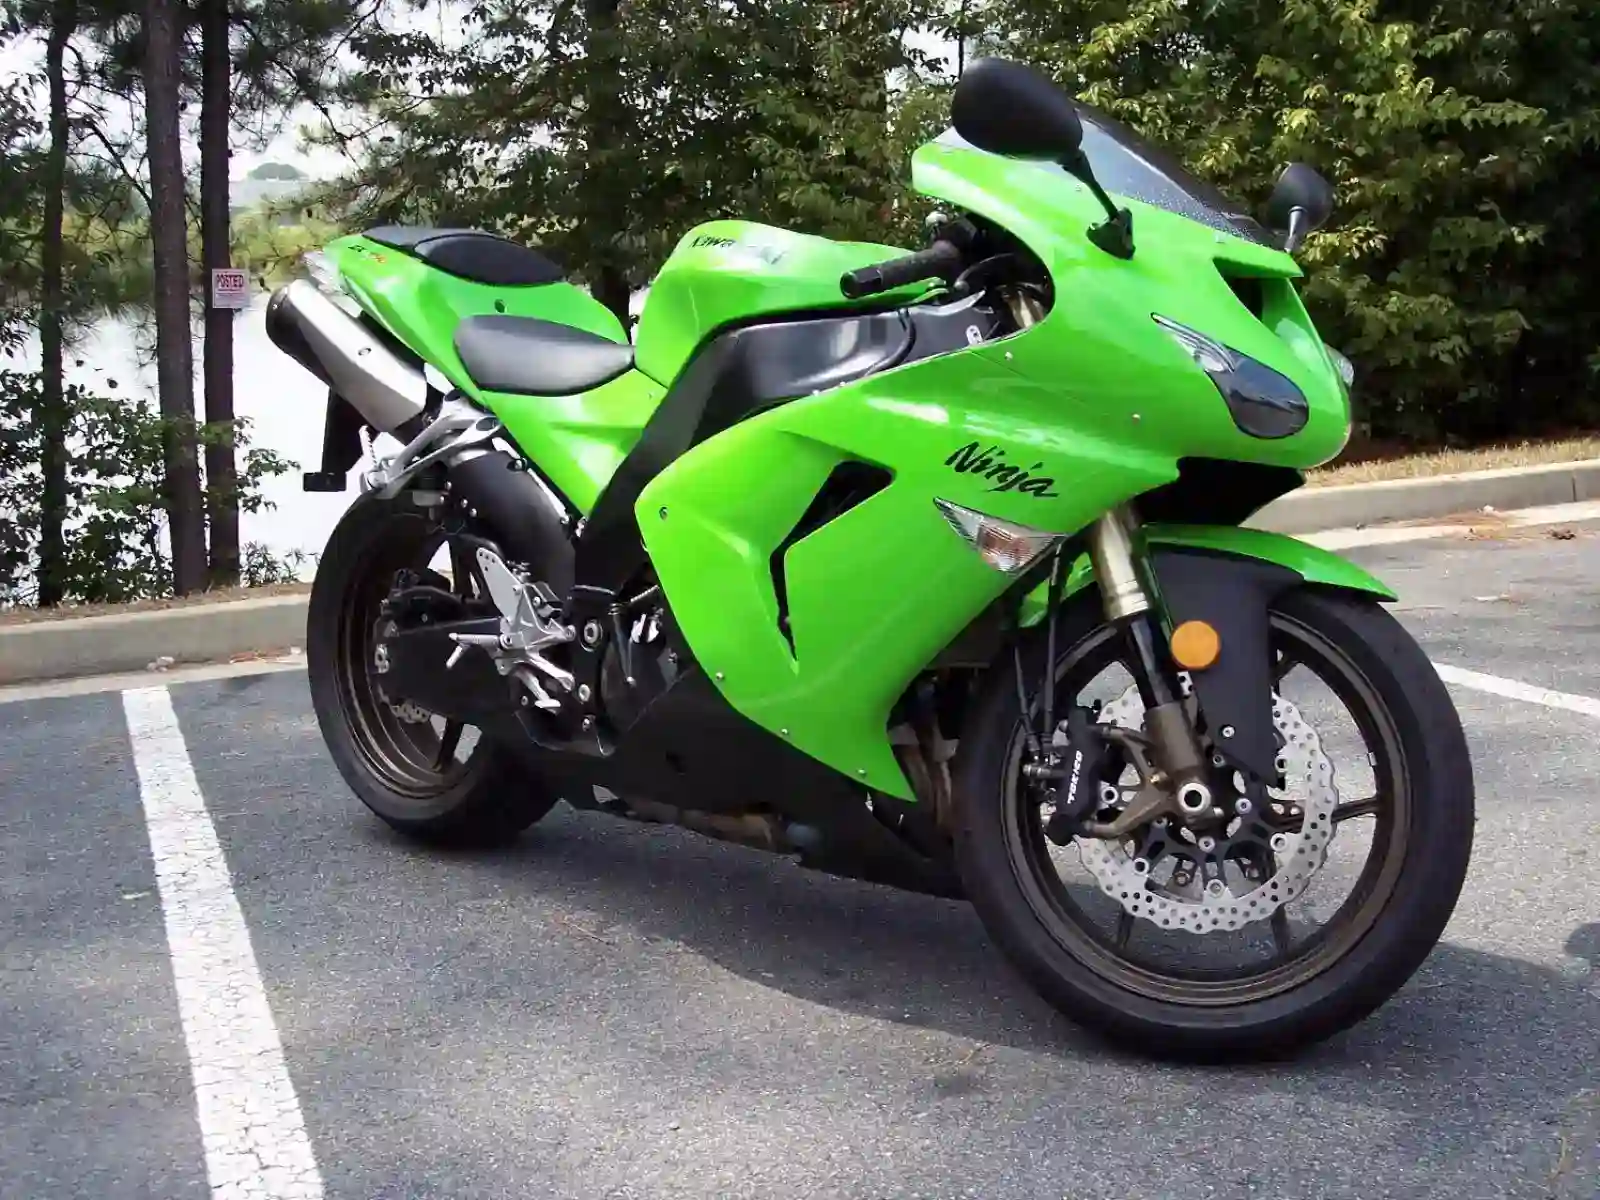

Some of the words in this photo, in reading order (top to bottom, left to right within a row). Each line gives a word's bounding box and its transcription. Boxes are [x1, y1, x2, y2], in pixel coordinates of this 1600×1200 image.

[216, 273, 244, 288] POSTED
[944, 441, 1059, 498] Ninja
[1066, 750, 1084, 804] TOKICO
